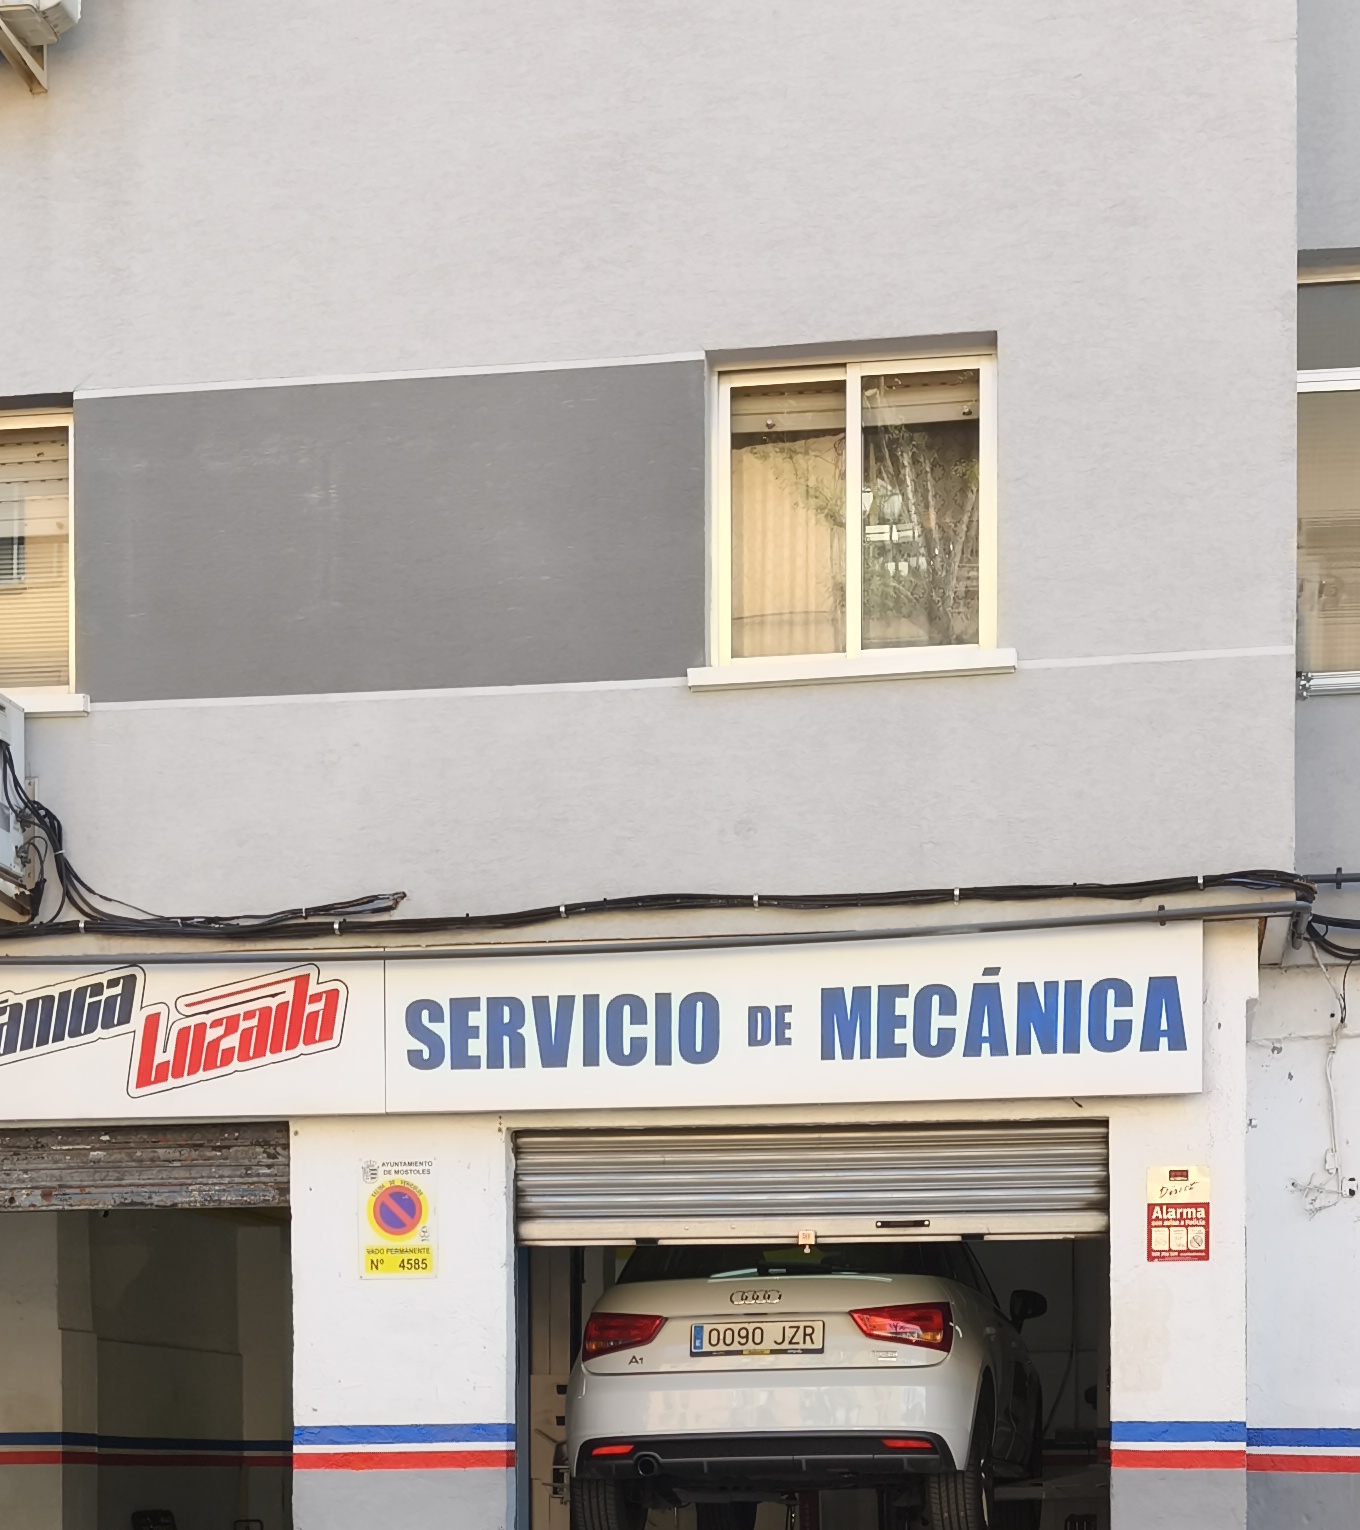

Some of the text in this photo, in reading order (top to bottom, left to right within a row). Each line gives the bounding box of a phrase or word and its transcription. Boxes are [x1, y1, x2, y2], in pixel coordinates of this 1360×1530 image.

[405, 967, 1188, 1071] SERVICIO DE MECÁNICA
[1152, 1205, 1206, 1219] Alarma
[370, 1258, 428, 1270] Nº 4585
[708, 1325, 815, 1347] 0090 JZR
[628, 1356, 644, 1364] A1
